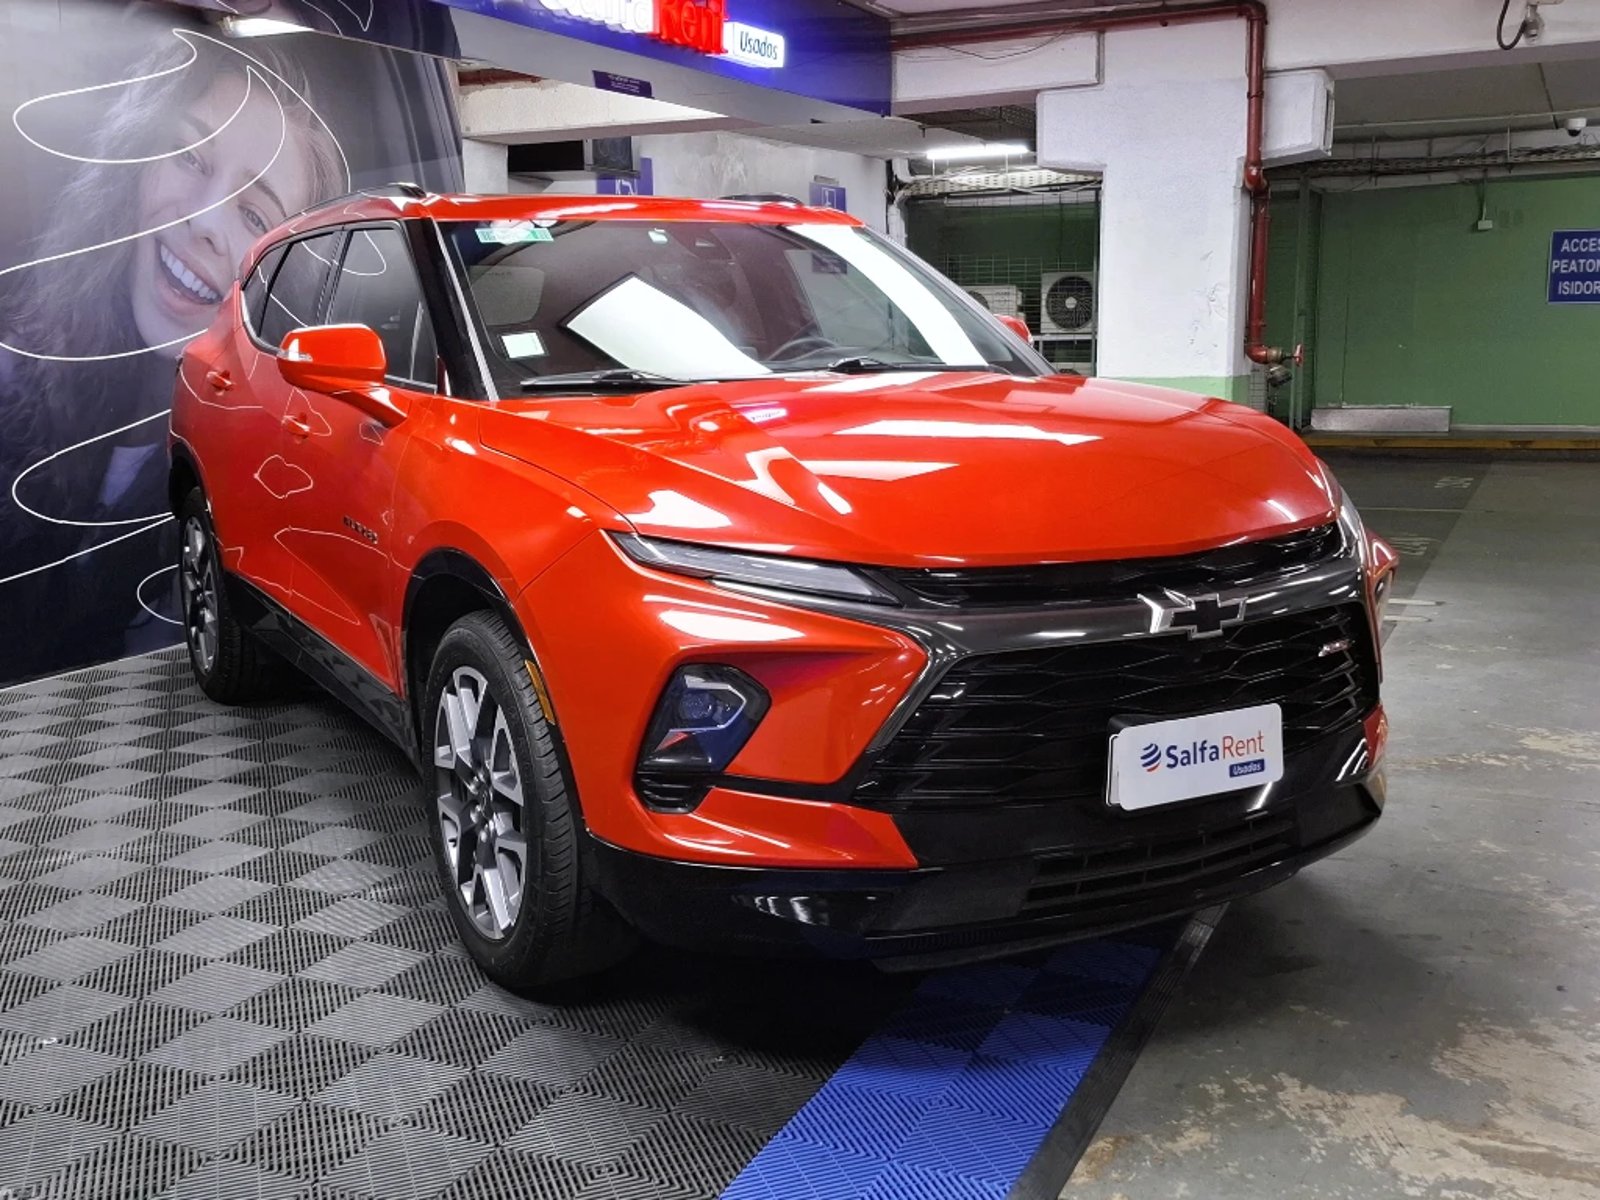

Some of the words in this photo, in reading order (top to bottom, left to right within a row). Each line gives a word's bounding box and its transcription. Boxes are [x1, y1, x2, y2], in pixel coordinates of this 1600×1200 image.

[740, 30, 778, 60] Usados
[1558, 281, 1600, 295] ISIDOR
[1165, 730, 1265, 769] SalfaRent
